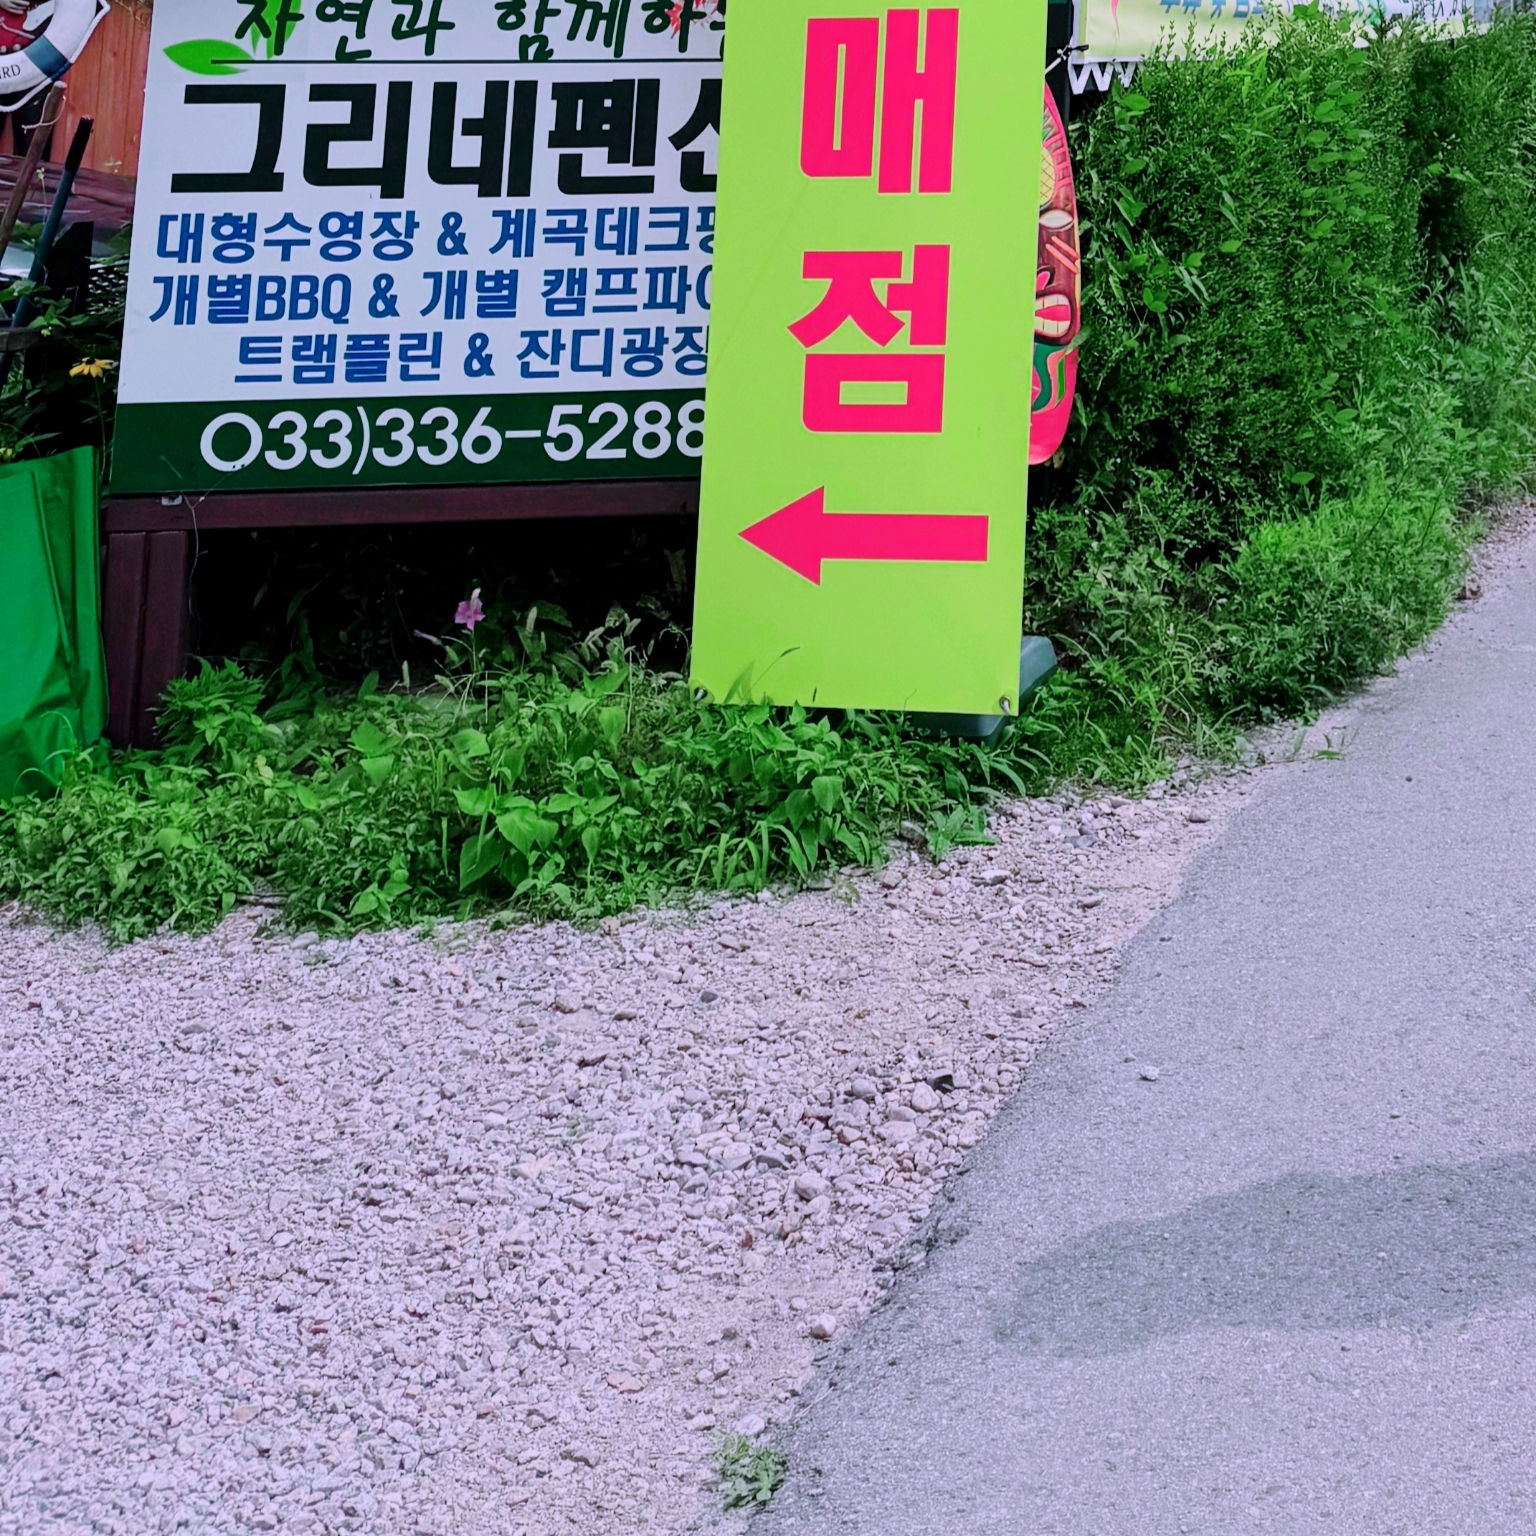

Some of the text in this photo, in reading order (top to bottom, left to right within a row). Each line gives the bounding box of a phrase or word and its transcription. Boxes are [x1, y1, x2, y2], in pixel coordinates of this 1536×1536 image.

[157, 211, 420, 264] 대형수영장
[437, 212, 468, 256] &
[787, 7, 960, 433] 매점
[149, 273, 352, 325] 개별BBQ
[368, 273, 400, 318] &
[420, 269, 518, 320] 개별
[235, 332, 442, 384] 트램플린
[464, 332, 495, 377] &
